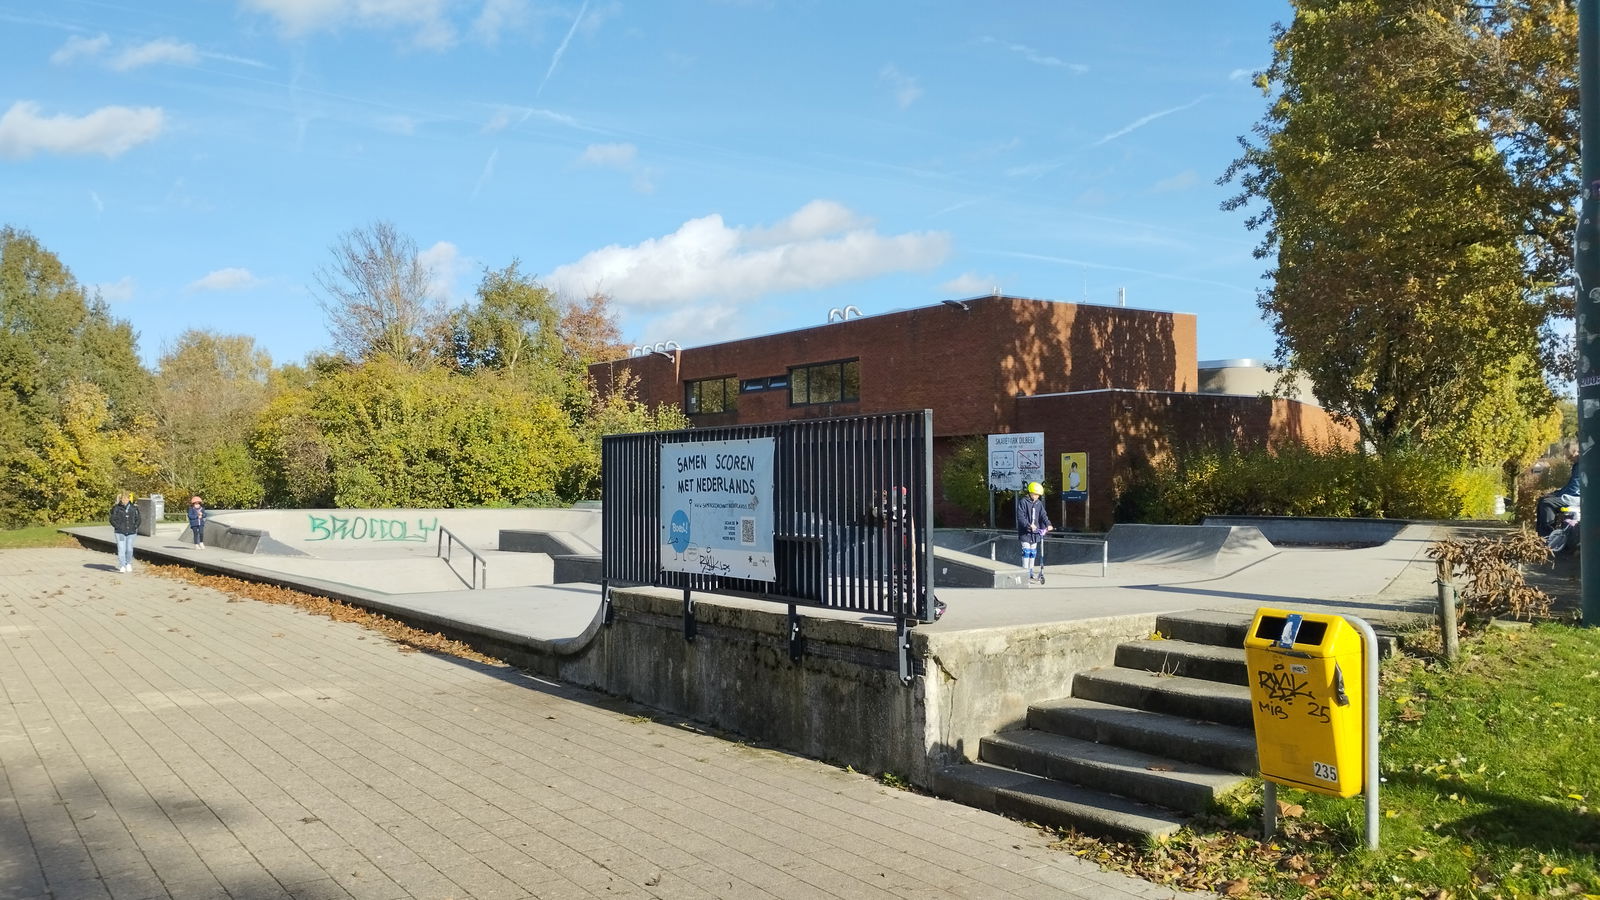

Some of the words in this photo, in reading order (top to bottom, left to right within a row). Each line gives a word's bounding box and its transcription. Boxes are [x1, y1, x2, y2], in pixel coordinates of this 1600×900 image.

[677, 455, 706, 473] SAMEN
[716, 453, 755, 471] SCOREN
[678, 478, 694, 494] MET
[696, 477, 756, 495] NEDERLANDS
[1308, 702, 1330, 723] 25
[1314, 762, 1337, 780] 235
